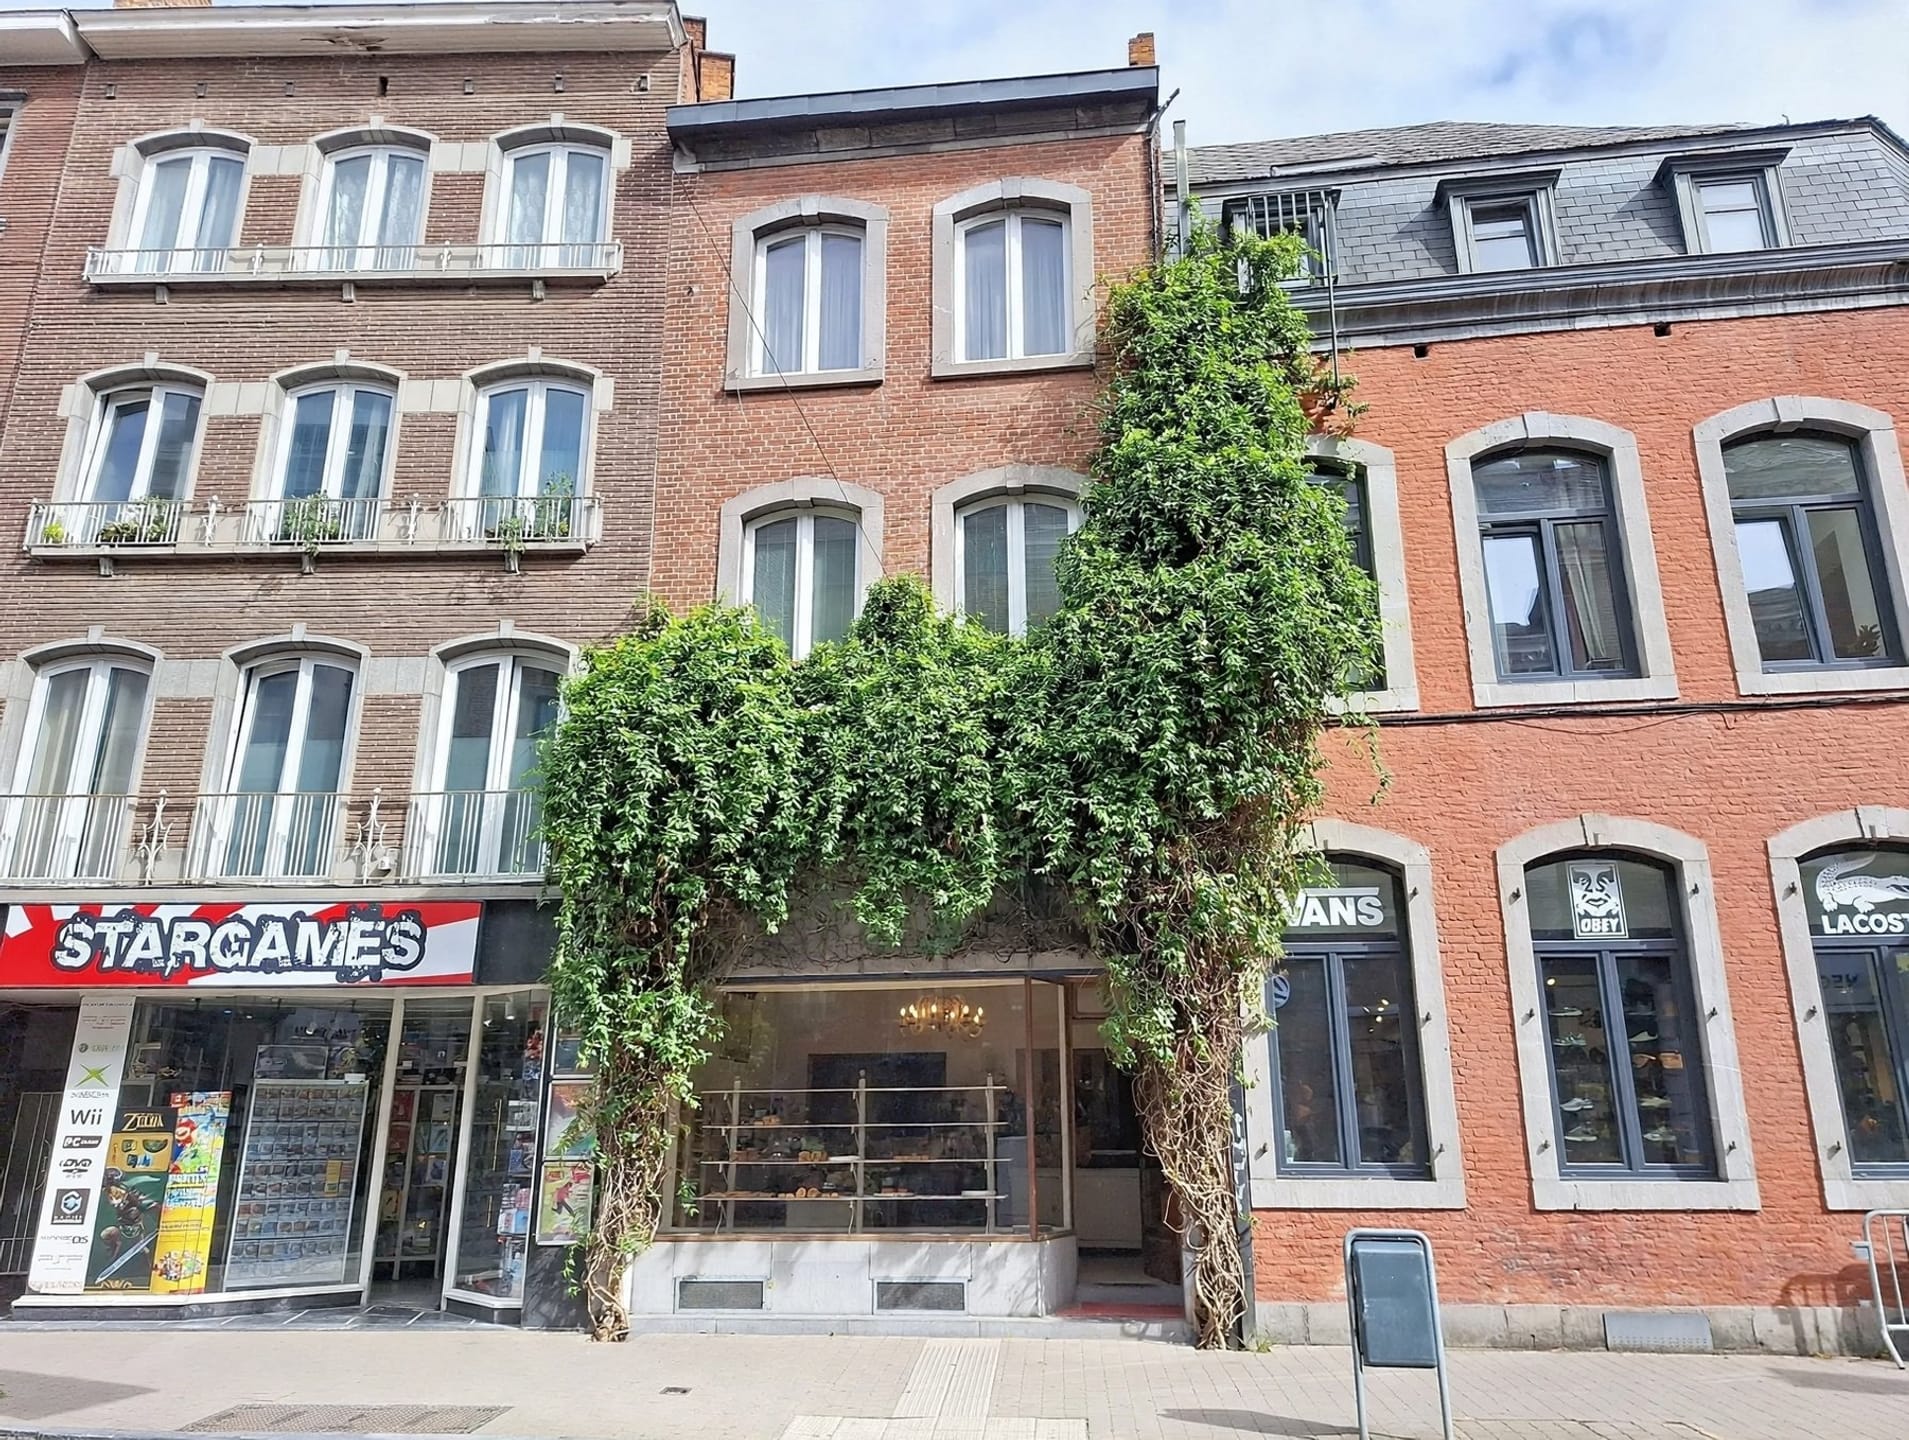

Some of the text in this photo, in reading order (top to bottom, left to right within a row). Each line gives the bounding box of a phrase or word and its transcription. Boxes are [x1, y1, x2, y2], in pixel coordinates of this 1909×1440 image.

[1281, 887, 1384, 926] VANS
[1581, 917, 1619, 932] OBEY
[54, 915, 426, 975] STARGAMES
[70, 1108, 103, 1125] Wii
